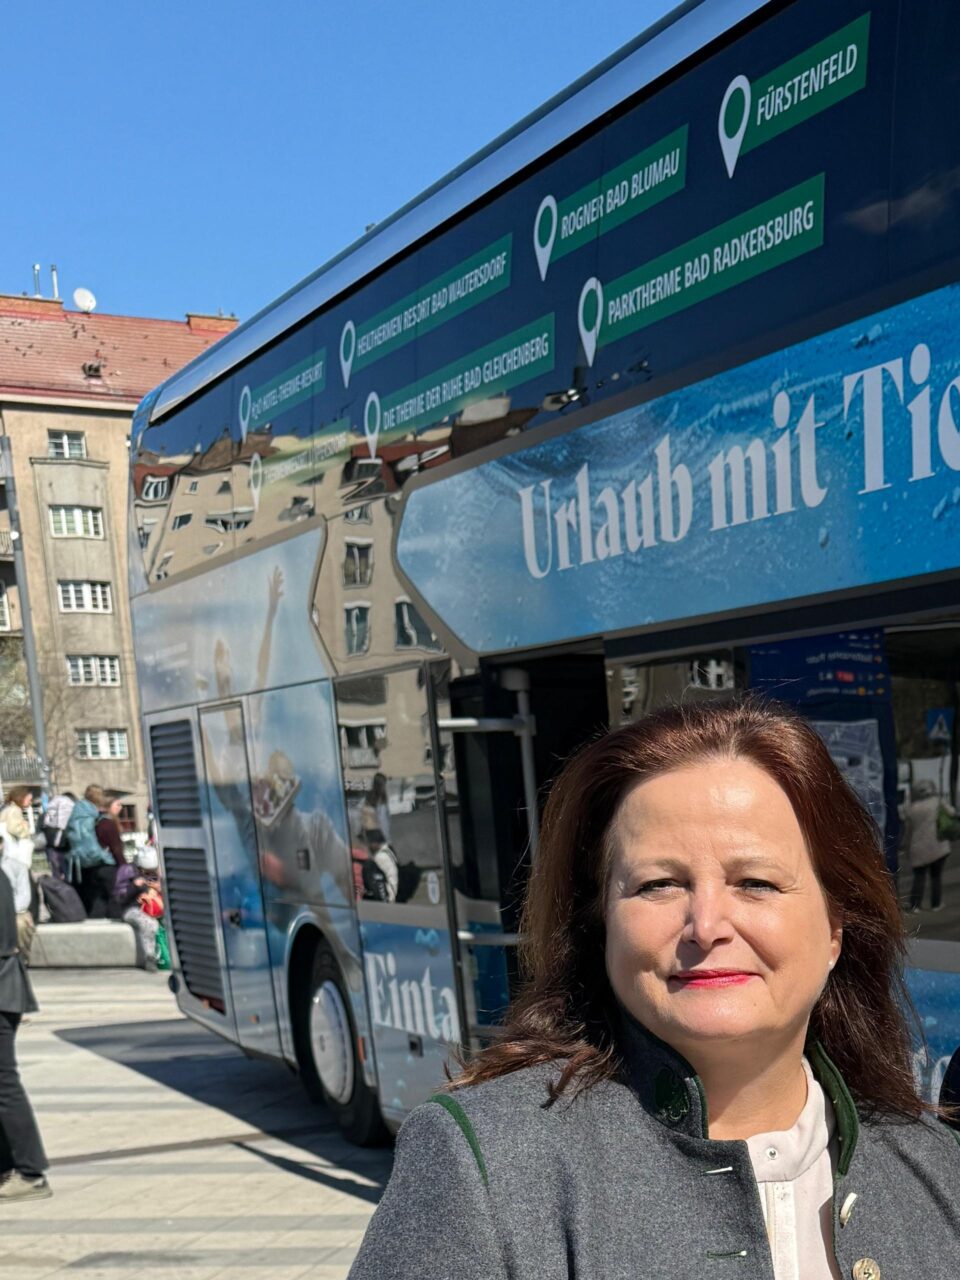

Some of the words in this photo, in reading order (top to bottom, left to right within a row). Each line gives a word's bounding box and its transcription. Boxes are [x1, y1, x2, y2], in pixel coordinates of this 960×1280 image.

[757, 43, 858, 126] FÜRSTENFELD
[561, 194, 603, 240] ROGNER
[606, 180, 629, 214] BAD
[631, 147, 681, 200] BLUMAU
[403, 297, 431, 331] RESORT
[431, 287, 448, 315] BAD
[448, 251, 507, 305] WALTERSDORF
[608, 266, 682, 326] PARKTHERME
[684, 253, 710, 289] BAD
[713, 200, 814, 274] RADKERSBURG
[383, 410, 396, 431] DIE
[396, 393, 424, 426] THERME
[425, 385, 442, 412] DER
[441, 376, 464, 406] RUHE
[463, 366, 482, 394] BAD
[482, 332, 549, 384] GLEICHENBERG
[518, 434, 693, 579] Urlaub
[708, 390, 828, 532] mit
[363, 952, 461, 1043] Einta
